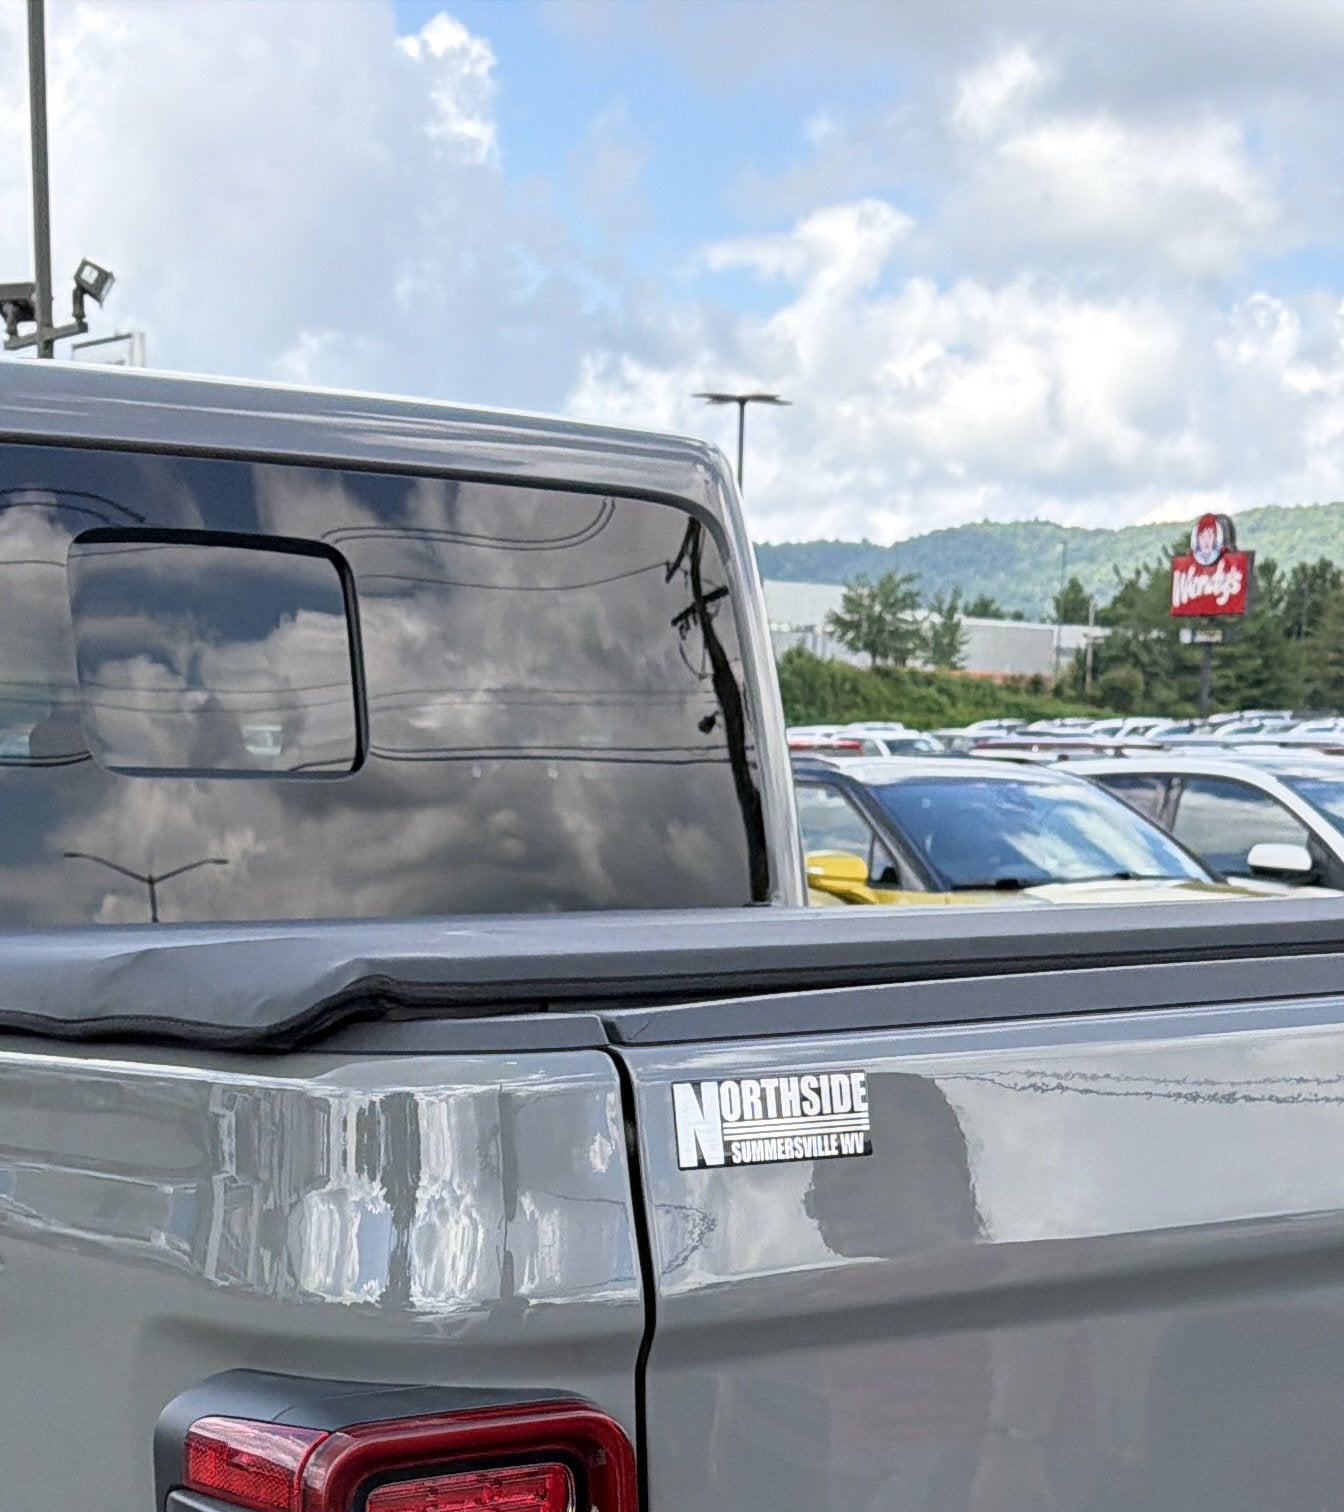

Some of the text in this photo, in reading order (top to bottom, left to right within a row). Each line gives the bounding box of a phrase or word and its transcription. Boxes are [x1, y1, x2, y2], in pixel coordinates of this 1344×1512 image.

[1172, 559, 1243, 608] Wendy's
[672, 1072, 870, 1168] NORTHSIDE
[731, 1132, 865, 1164] SUMMERSVILLE WV
